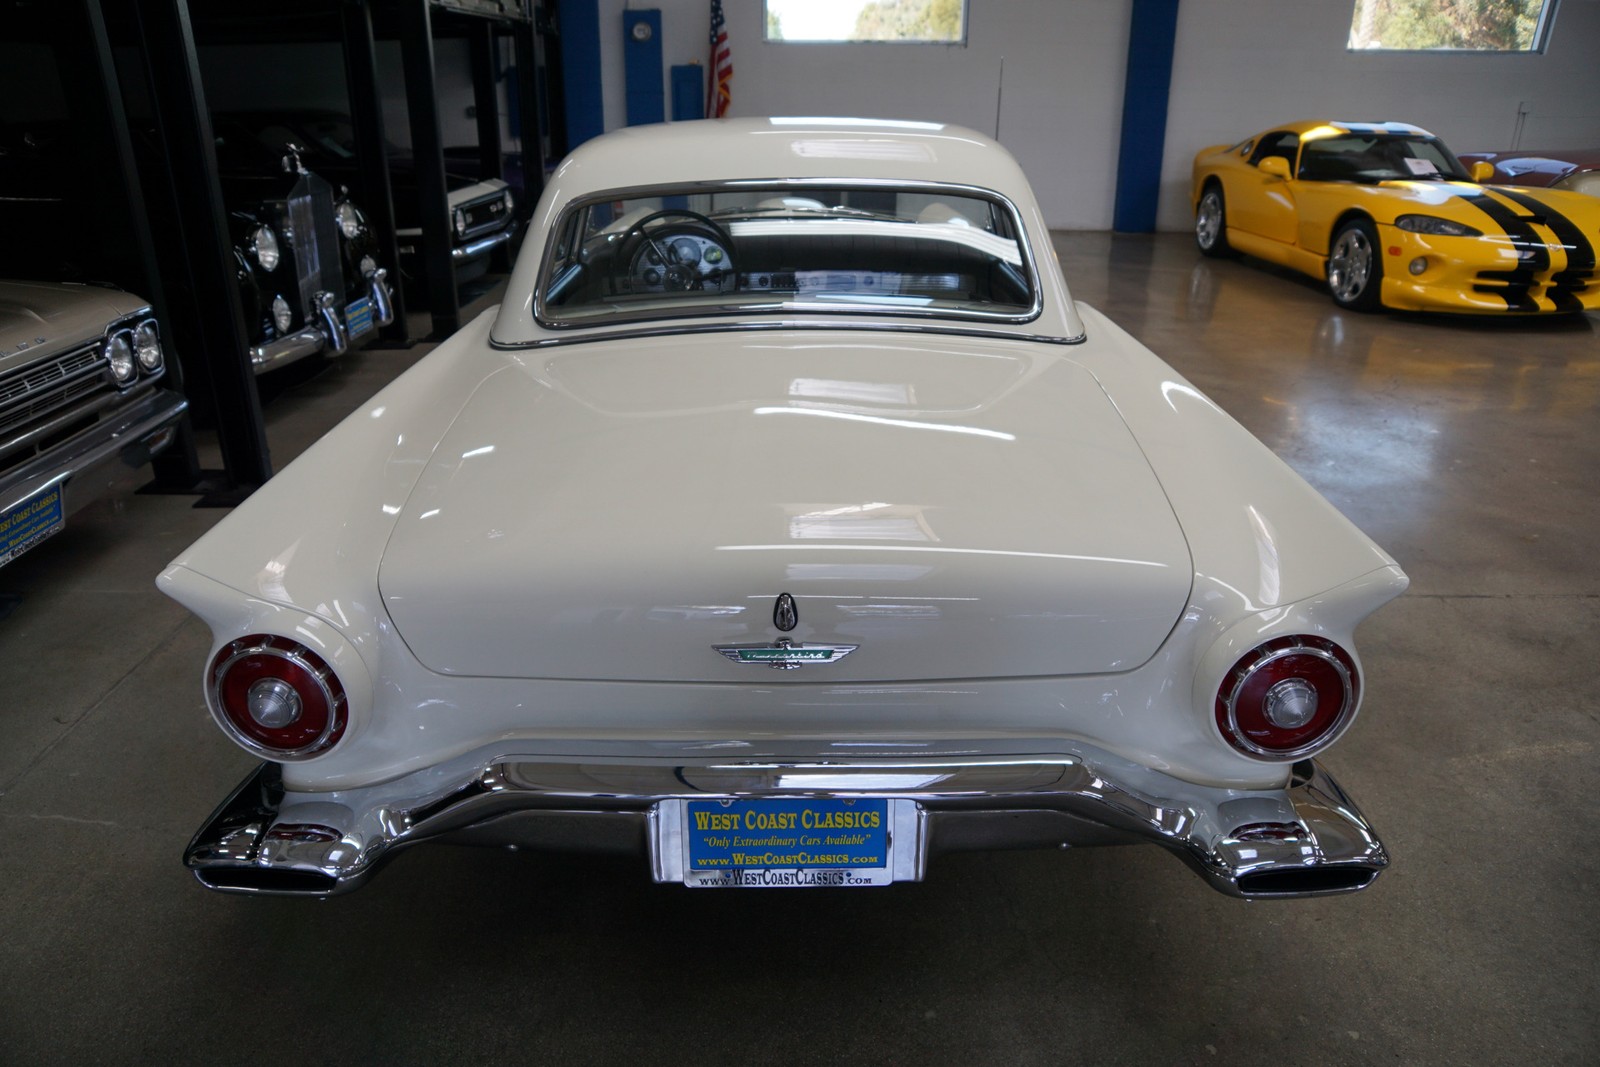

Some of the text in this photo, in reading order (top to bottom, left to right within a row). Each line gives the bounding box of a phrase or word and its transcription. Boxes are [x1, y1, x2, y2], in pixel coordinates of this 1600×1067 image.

[694, 808, 880, 830] WEST COAST CLASSICS
[733, 835, 798, 848] Extraordinary
[800, 834, 821, 846] Cars
